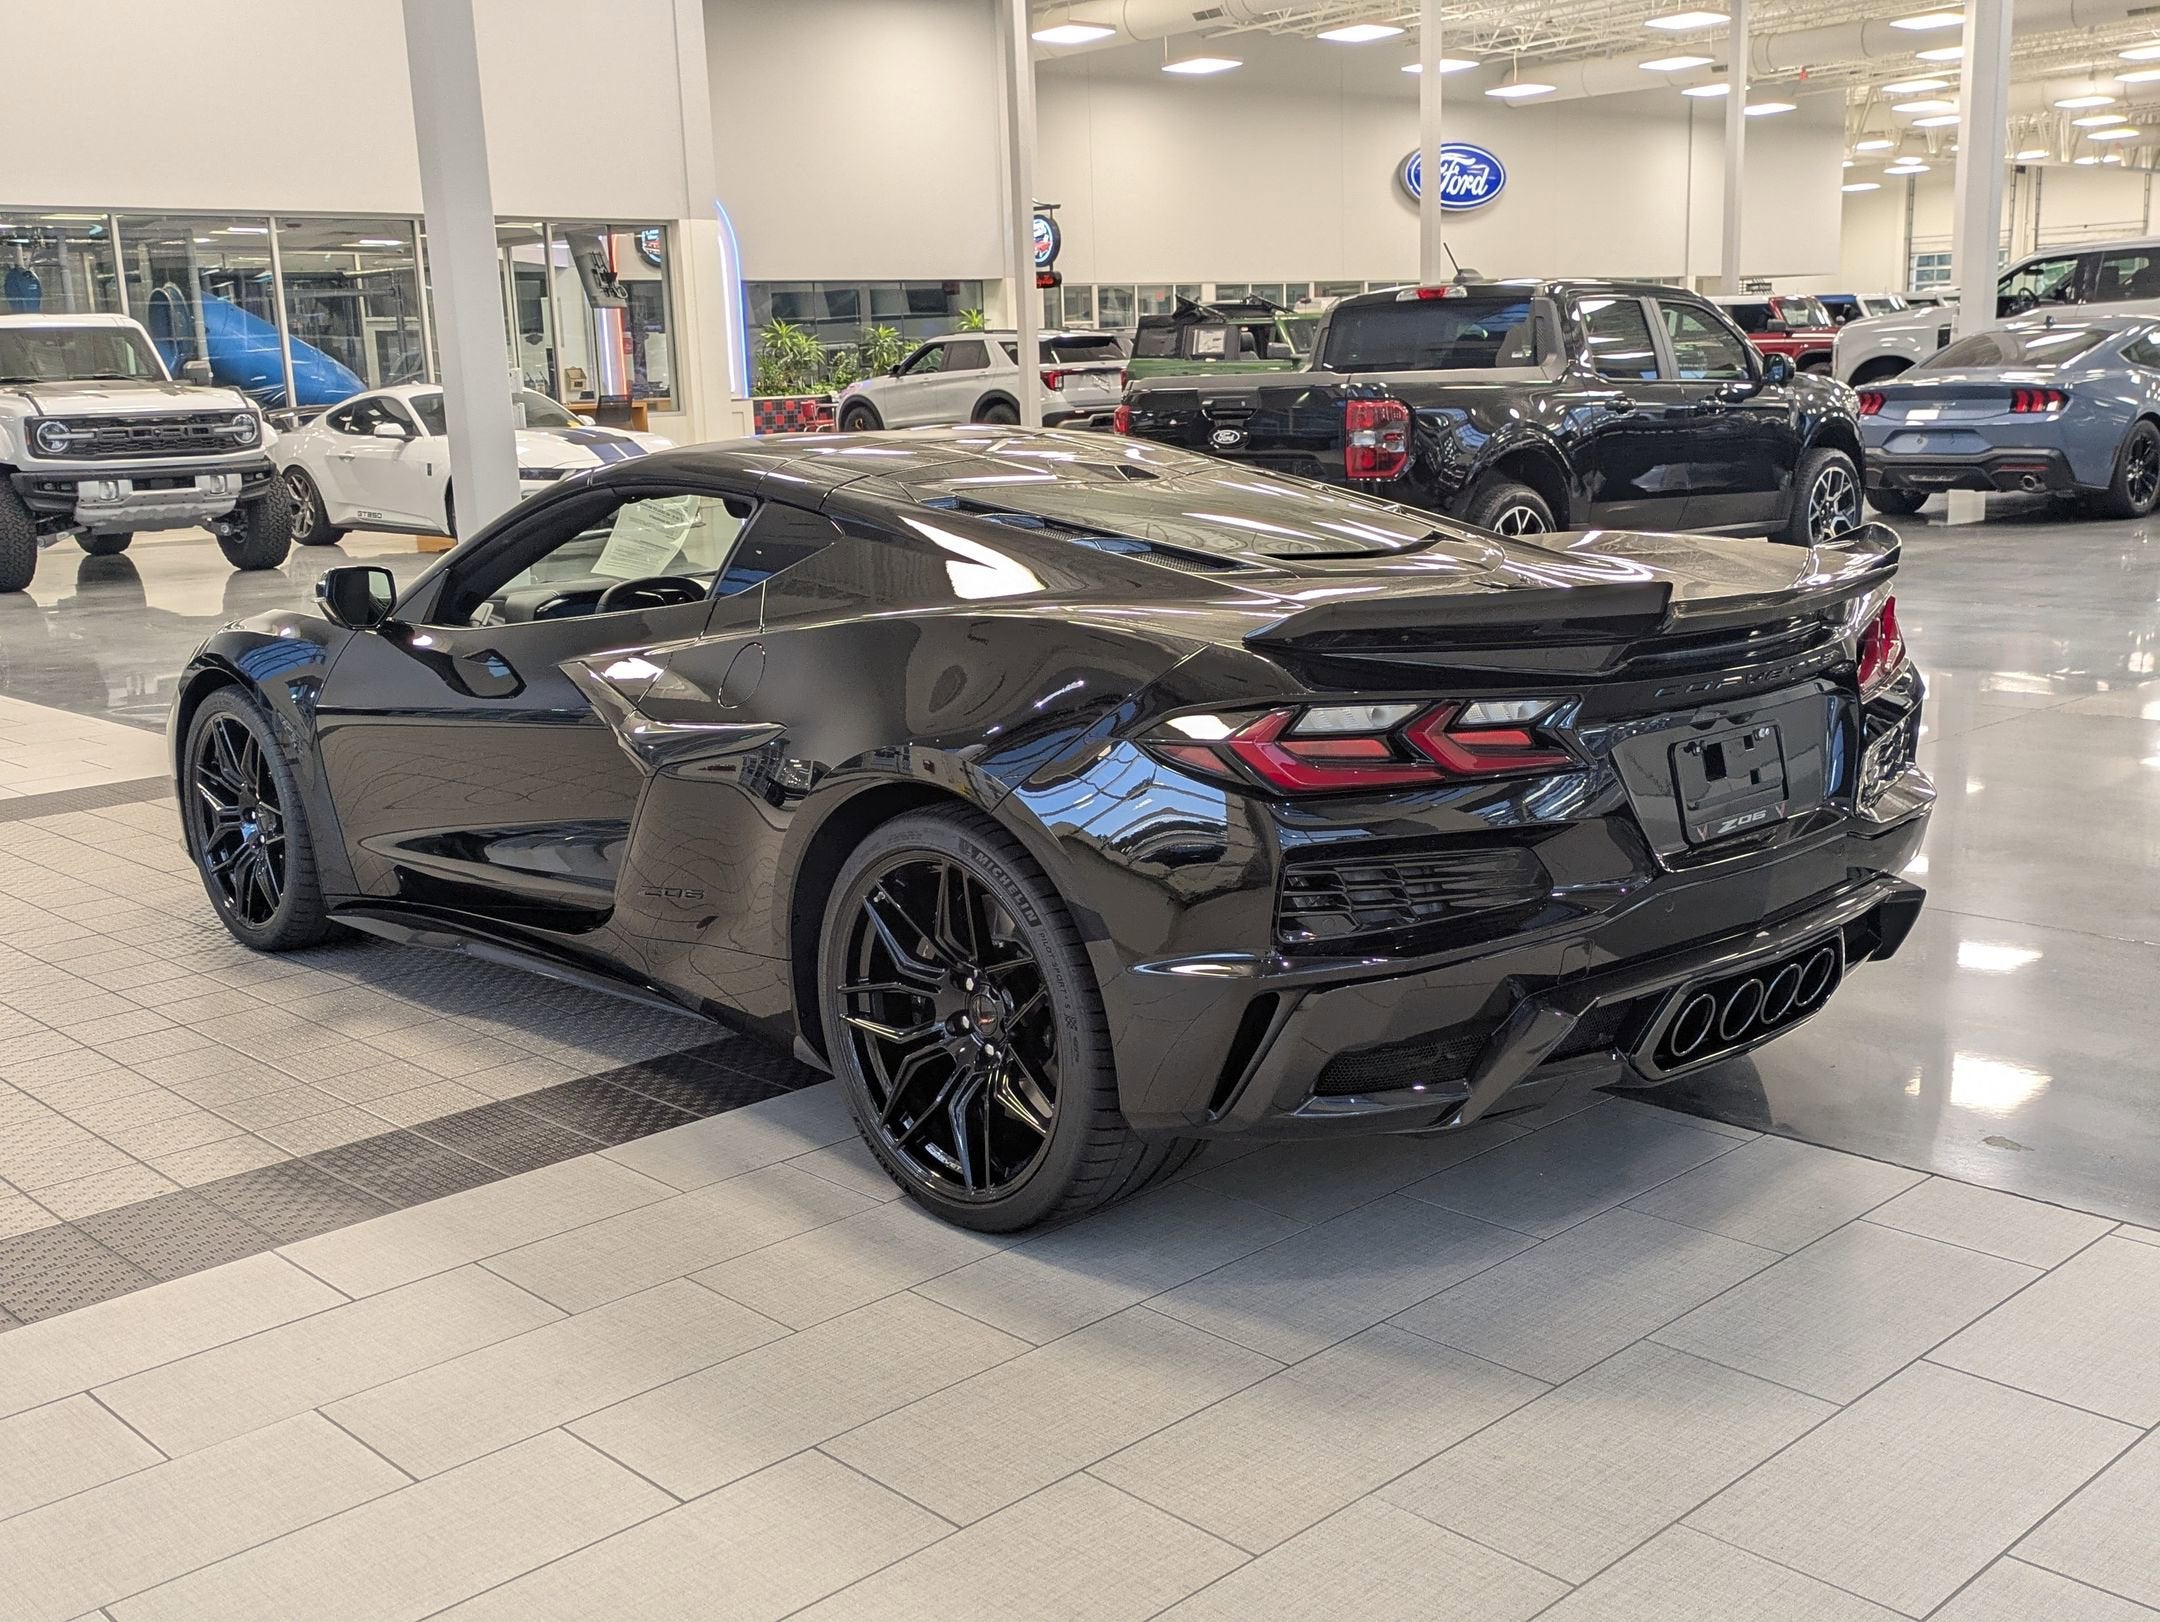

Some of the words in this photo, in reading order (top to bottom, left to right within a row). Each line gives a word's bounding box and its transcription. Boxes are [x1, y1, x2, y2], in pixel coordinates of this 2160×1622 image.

[1440, 152, 1489, 196] Ford
[1654, 650, 1841, 697] CORVETTE
[1717, 810, 1768, 834] Z06
[639, 885, 704, 899] Z06
[975, 851, 1038, 923] MICHELIN
